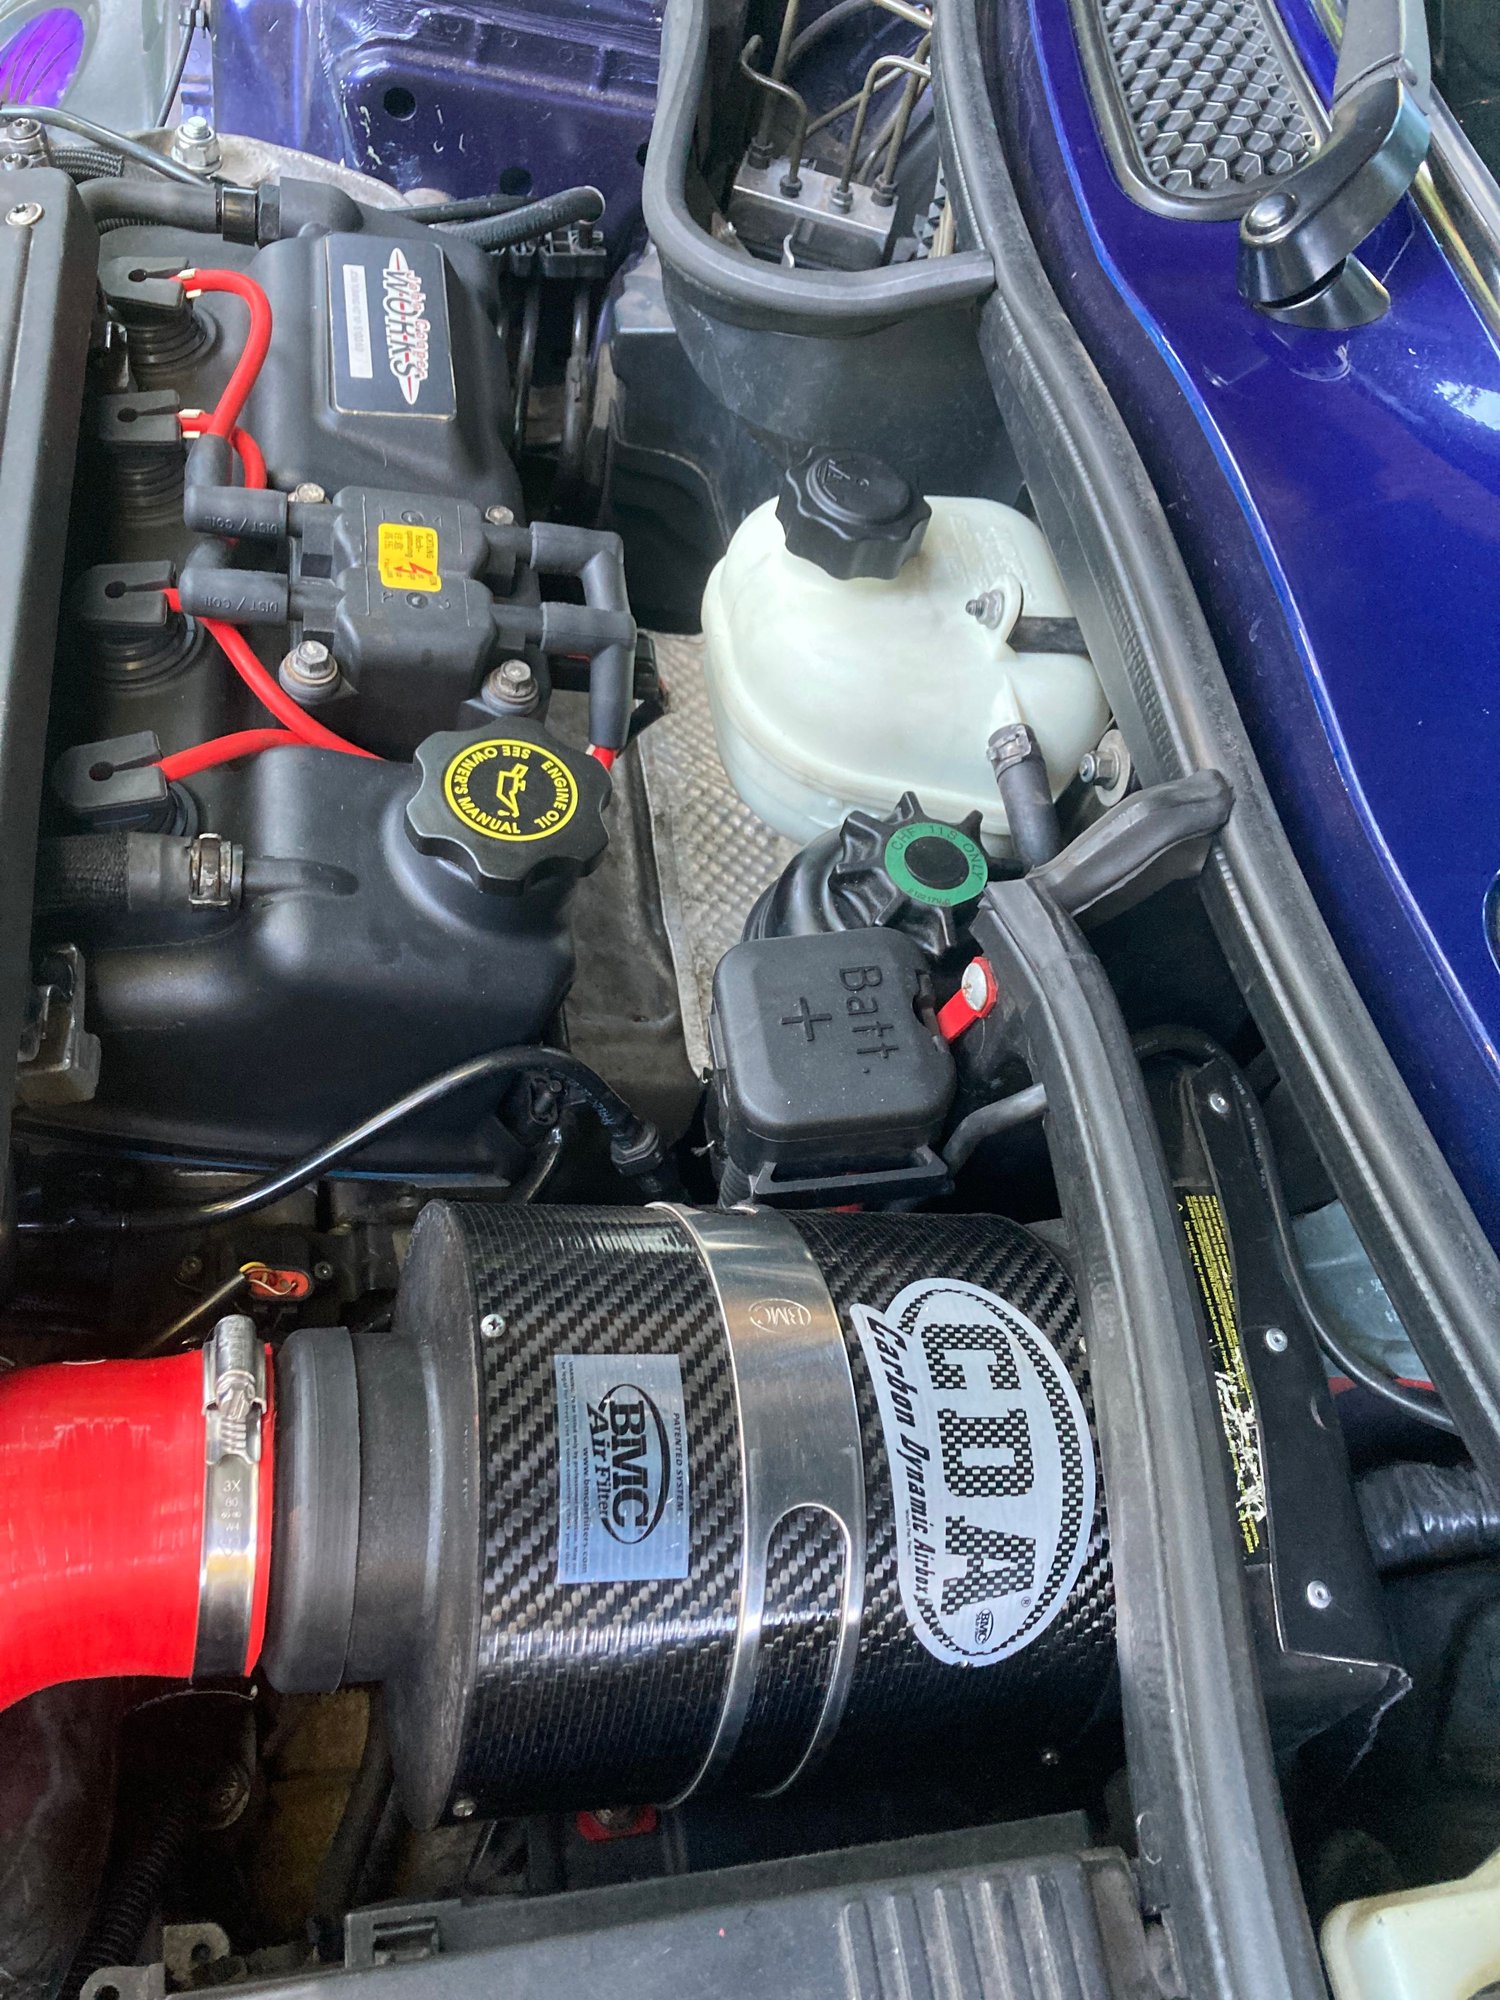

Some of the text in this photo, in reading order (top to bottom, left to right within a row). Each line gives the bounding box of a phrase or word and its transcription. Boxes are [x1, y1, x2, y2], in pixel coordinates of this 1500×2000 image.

[385, 270, 421, 379] WORKS
[454, 745, 531, 834] SEE OWNER'S MANUAL
[533, 760, 570, 829] ENGINE OIL
[891, 827, 918, 851] CHF
[962, 843, 986, 881] ONLY
[581, 1447, 591, 1573] www.bmcairfilters.com
[587, 1402, 611, 1519] Air Filter
[609, 1400, 649, 1527] BMC
[673, 1412, 685, 1512] PATENTED SYSTEM
[866, 1316, 936, 1595] Carbon Dynamic Airbox
[920, 1323, 1036, 1616] CDA
